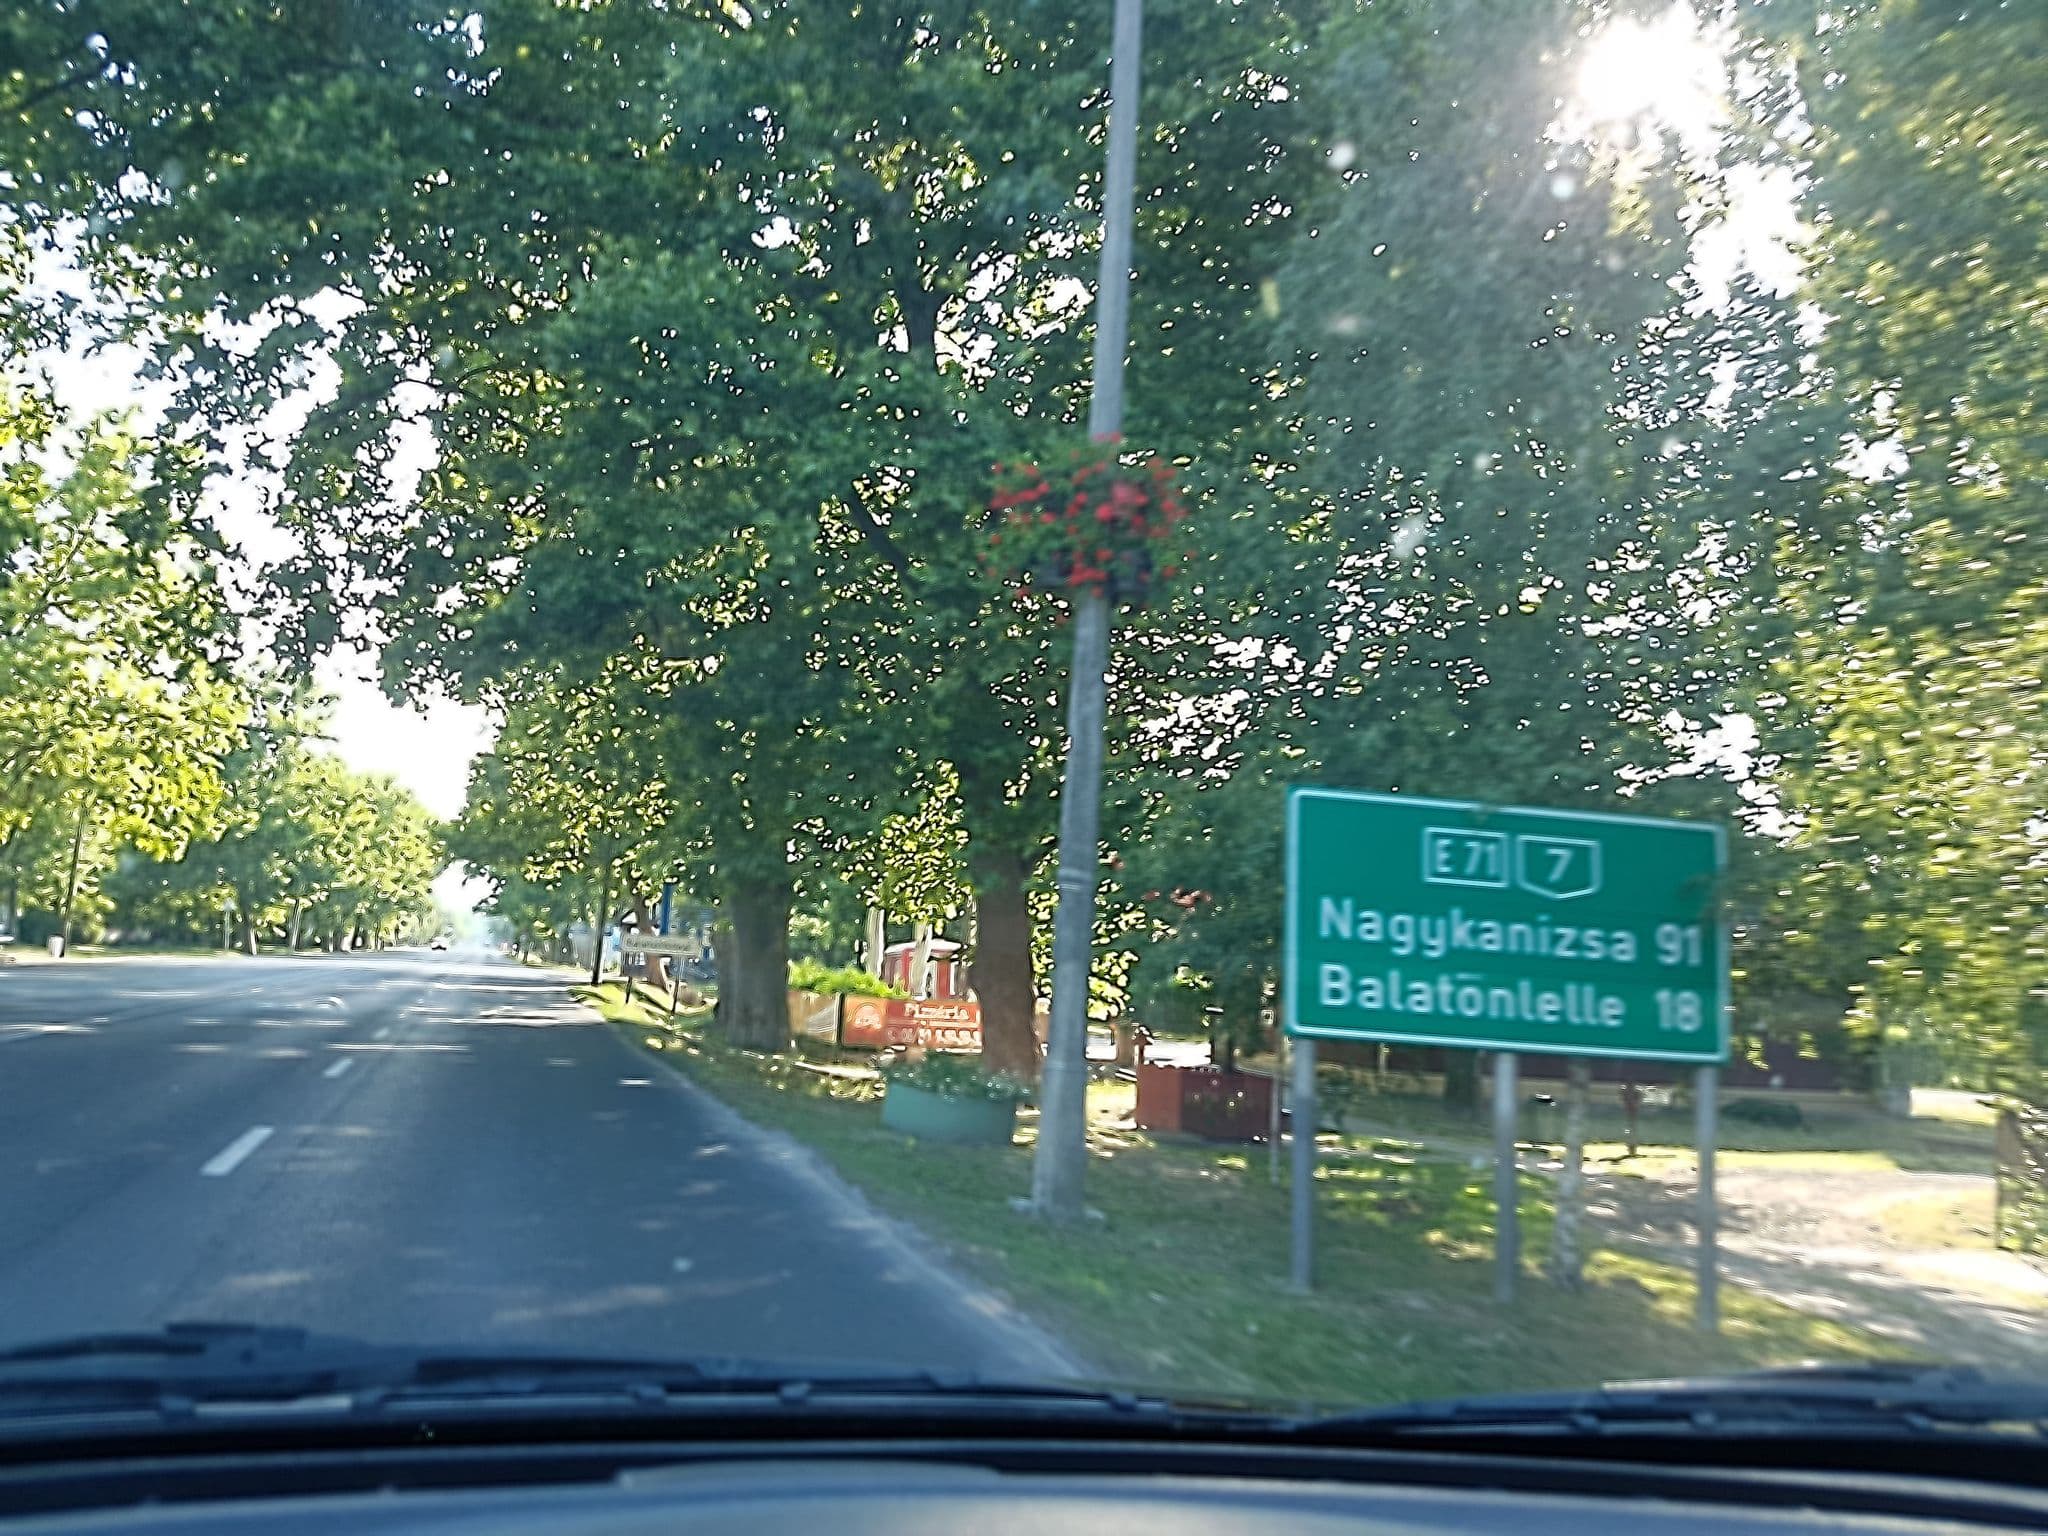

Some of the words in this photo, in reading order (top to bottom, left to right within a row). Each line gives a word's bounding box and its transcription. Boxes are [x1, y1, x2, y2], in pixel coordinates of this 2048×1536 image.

[1435, 839, 1453, 873] E
[1464, 842, 1499, 876] 71
[1547, 849, 1574, 883] 7
[1319, 897, 1637, 962] Nagykanizsa
[1655, 923, 1701, 966] 91
[1655, 990, 1702, 1033] 18
